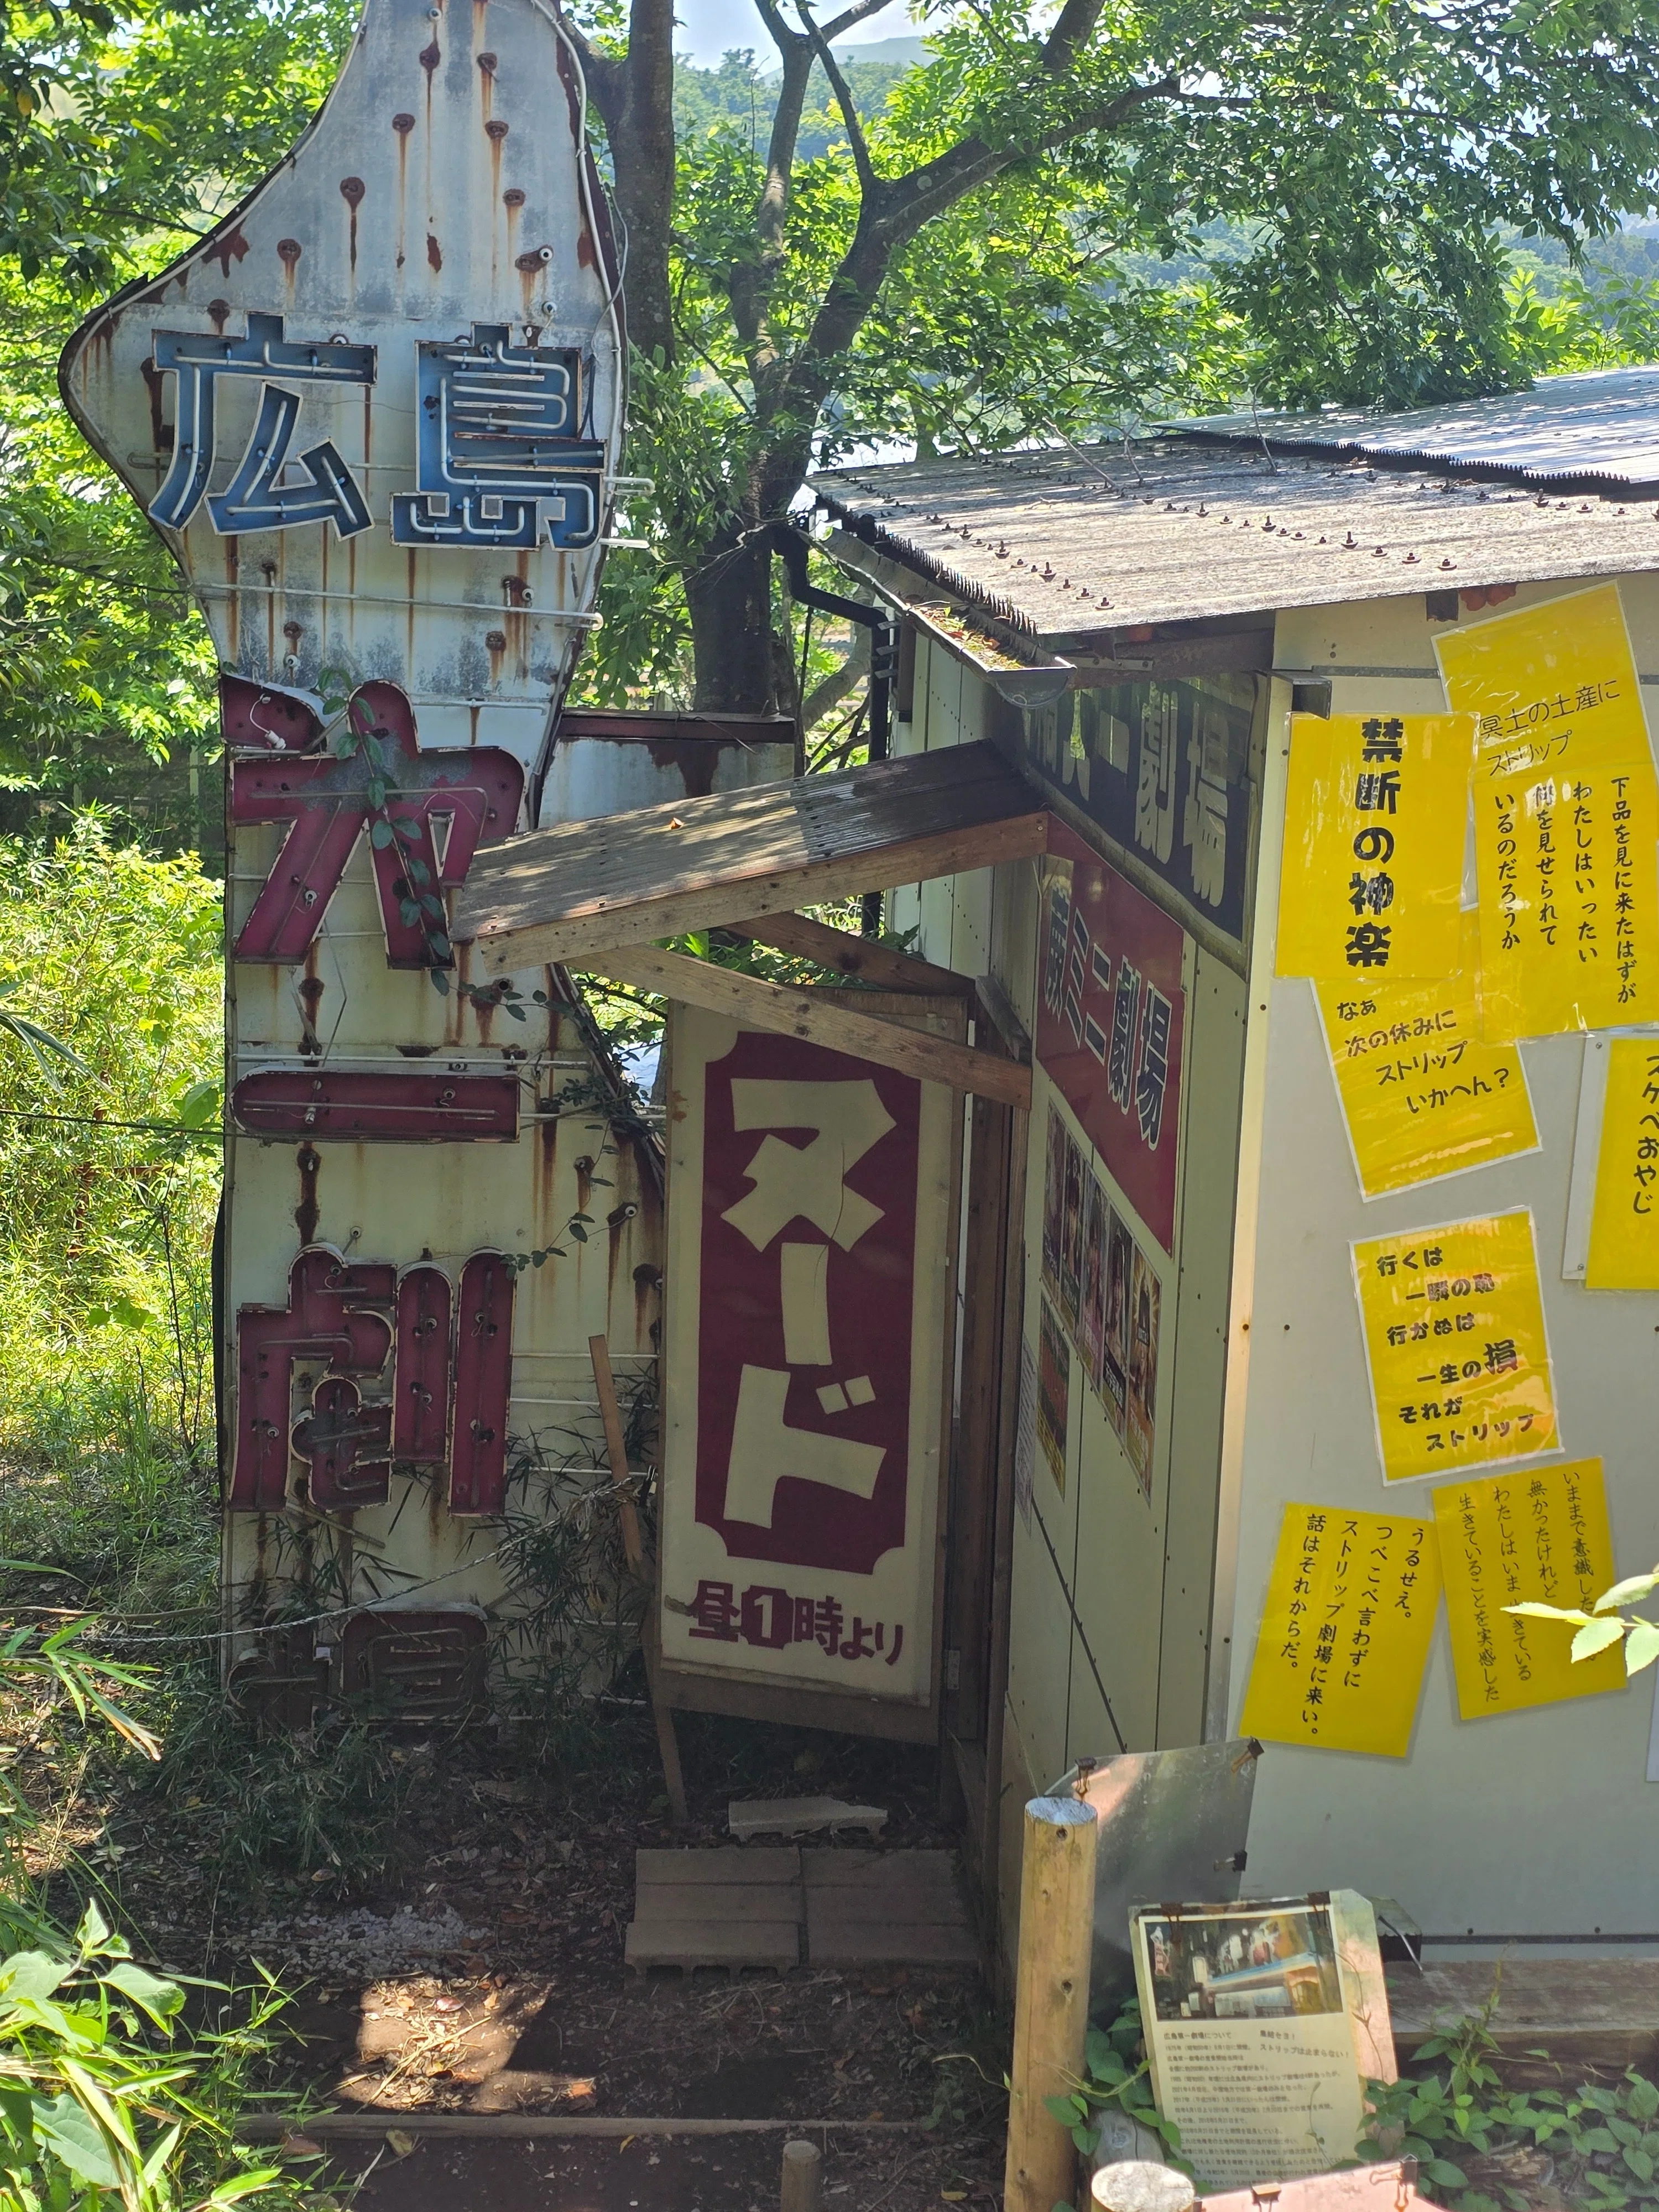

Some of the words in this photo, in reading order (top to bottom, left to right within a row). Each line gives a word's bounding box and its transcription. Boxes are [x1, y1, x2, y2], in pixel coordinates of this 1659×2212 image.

[148, 311, 607, 553] 広島
[1479, 680, 1620, 739] 冥土の土産に
[1487, 729, 1572, 776] ストリップ
[1344, 717, 1404, 968] 禁断の神楽
[1495, 794, 1521, 950] いるのだろうか
[1535, 785, 1558, 946] 何を見せられて
[1573, 781, 1598, 963] わたしはいったい
[1611, 776, 1637, 1004] 下品を見に来たはずが
[1344, 1010, 1457, 1057] 次の休みに
[1376, 1041, 1468, 1086] ストリップ
[721, 1077, 897, 1529] ヌード
[1376, 1246, 1443, 1277] 行くは
[1406, 1272, 1495, 1302] 一瞬の恥
[1386, 1312, 1475, 1347] 行かぬは
[1417, 1339, 1517, 1385] 一生の損
[1399, 1396, 1463, 1424] それが
[1426, 1413, 1534, 1452] ストリップ
[1280, 1513, 1327, 1668] 話はそれからだ。
[1395, 1527, 1424, 1618] うるせえ。
[1458, 1493, 1500, 1702] 生きていることを実感した
[1527, 1480, 1558, 1598] 無かったけれど
[1302, 1520, 1358, 1735] ストリップ劇場に来い。
[1344, 1526, 1393, 1687] つべこべ言わずに
